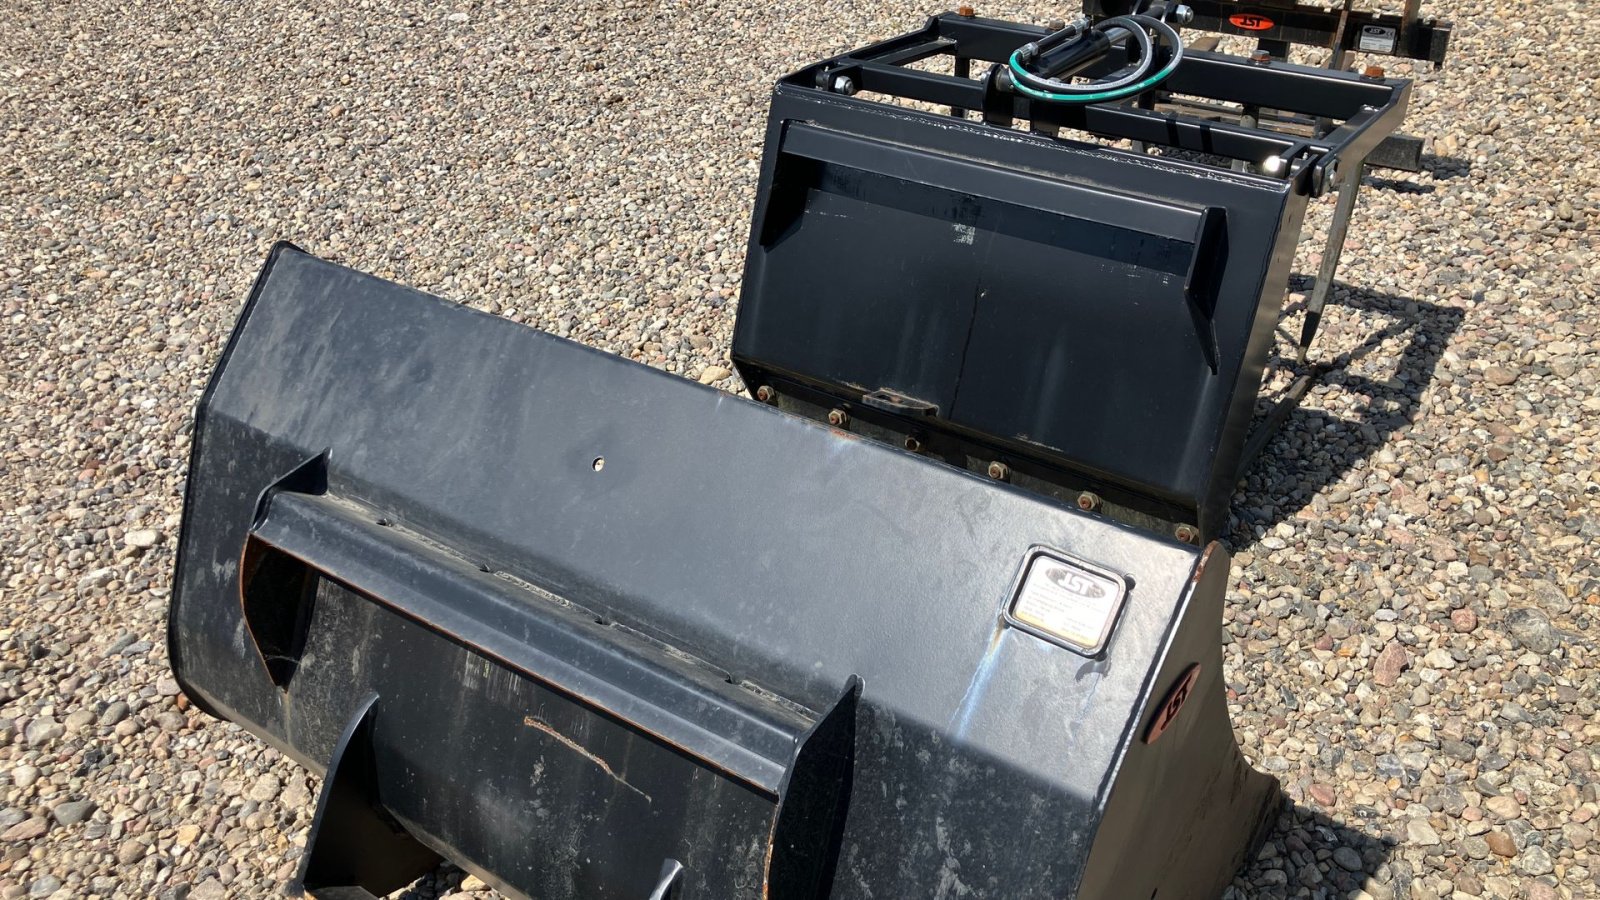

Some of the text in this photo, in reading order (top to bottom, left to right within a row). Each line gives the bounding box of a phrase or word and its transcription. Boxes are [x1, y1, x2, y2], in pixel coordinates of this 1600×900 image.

[1240, 16, 1263, 27] JST
[1058, 572, 1094, 595] JST
[1161, 673, 1192, 730] JST
